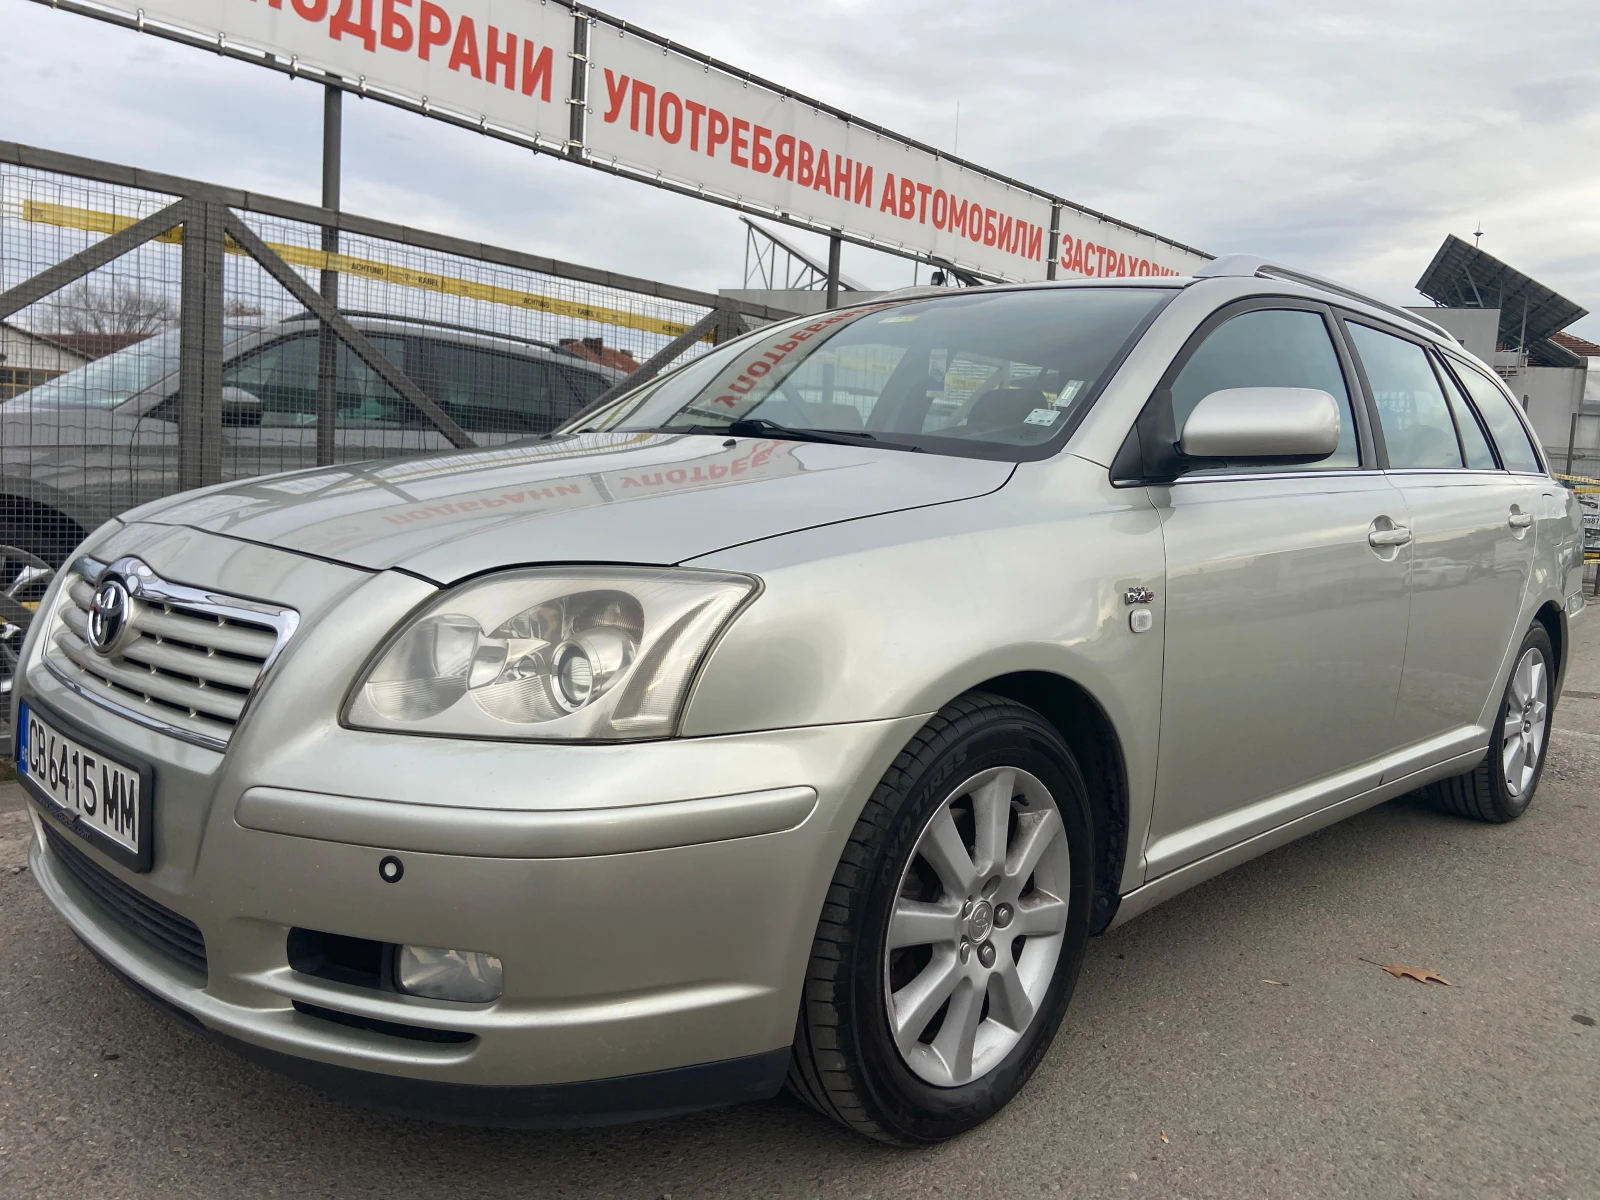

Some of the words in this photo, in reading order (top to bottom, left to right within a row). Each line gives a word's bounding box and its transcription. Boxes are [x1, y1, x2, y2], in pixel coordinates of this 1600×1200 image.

[250, 0, 553, 103] ДБРАНИ
[604, 68, 873, 208] УПОТРЕБЯВАНИ
[880, 173, 1043, 262] АВТОМОБИЛИ
[351, 262, 384, 276] ACHTUNG
[50, 735, 97, 816] 6415
[103, 764, 136, 842] MM
[911, 750, 968, 816] TIRES
